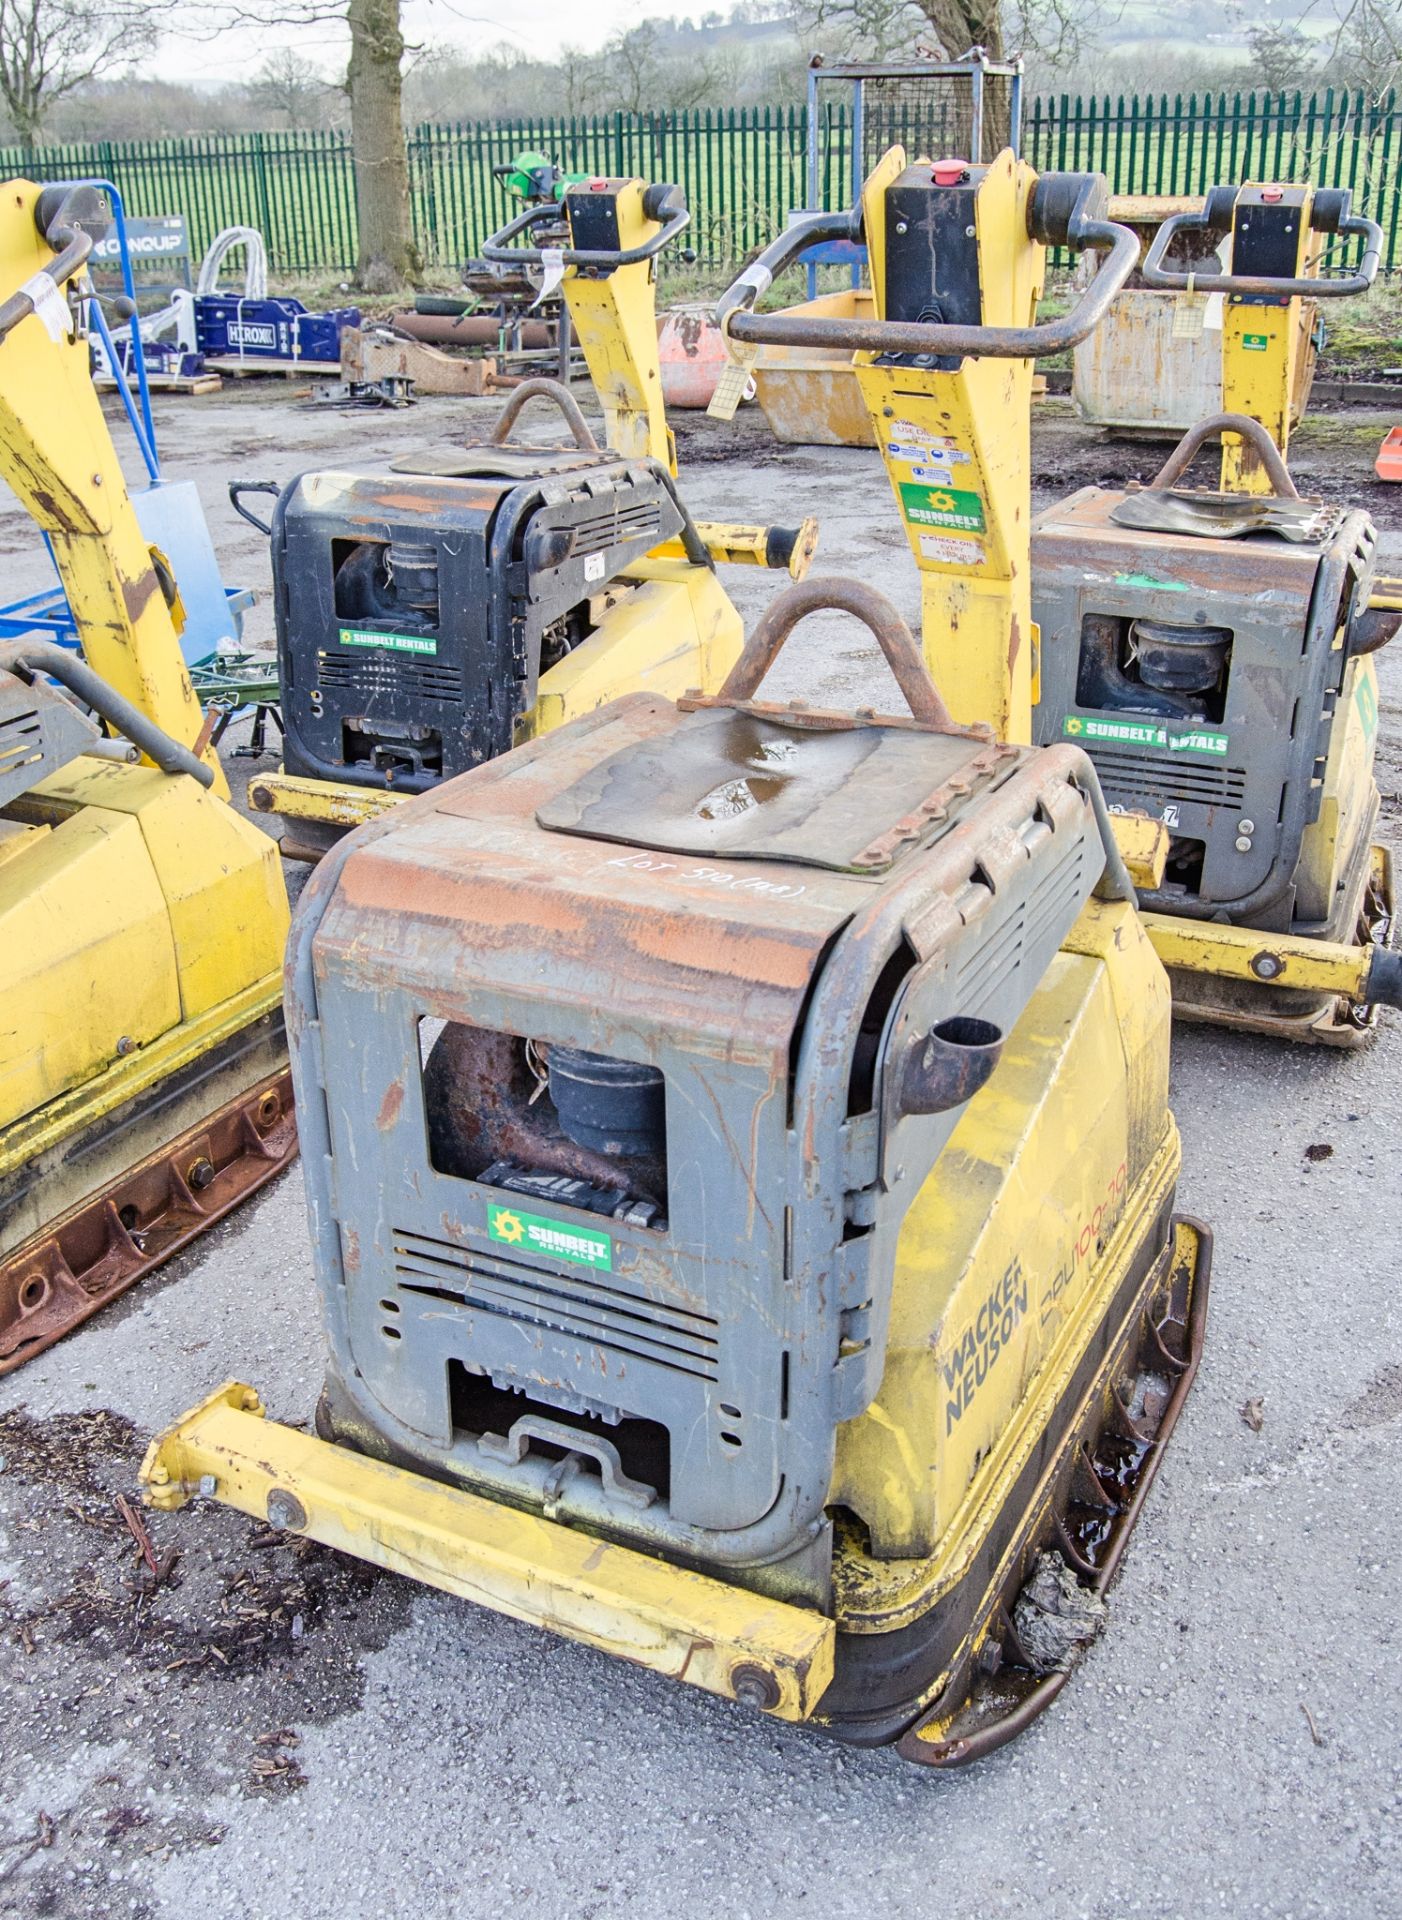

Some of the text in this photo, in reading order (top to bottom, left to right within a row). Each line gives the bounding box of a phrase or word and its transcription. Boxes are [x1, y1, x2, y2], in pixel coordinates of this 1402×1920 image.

[107, 235, 181, 253] CNQUIP
[230, 326, 272, 344] HIROX
[908, 508, 979, 526] SUNBELT
[920, 518, 971, 529] RENTALS
[354, 634, 435, 651] SUNBELT RENTALS
[1087, 722, 1154, 741] SUNBELT
[607, 853, 676, 871] LOT
[528, 1224, 606, 1257] SUNBELT
[540, 1242, 595, 1261] RENTALS
[946, 1280, 1027, 1436] NEUSON
